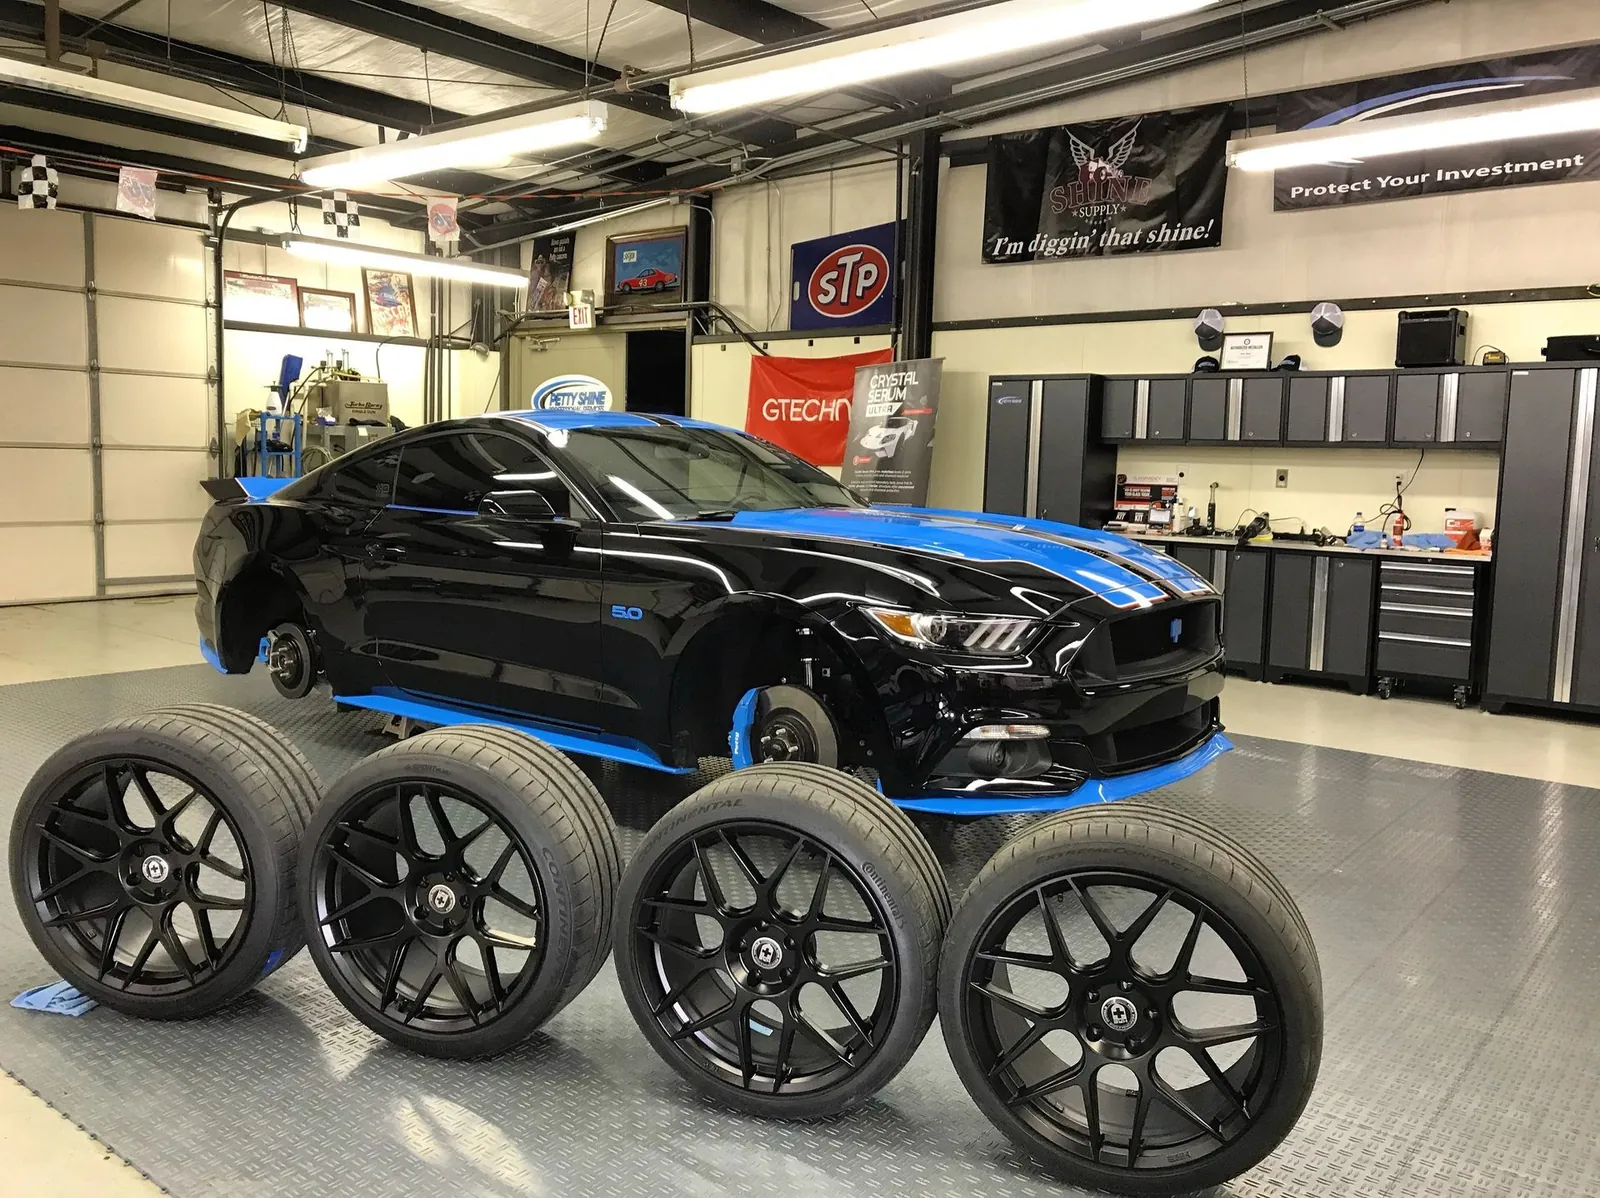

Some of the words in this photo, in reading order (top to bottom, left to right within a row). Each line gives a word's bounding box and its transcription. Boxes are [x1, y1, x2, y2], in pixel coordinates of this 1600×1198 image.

[1290, 178, 1372, 199] Protect
[1376, 171, 1430, 189] Your
[1436, 153, 1585, 182] Investment
[1049, 175, 1153, 214] SHINE
[1078, 203, 1121, 218] SUPPLY
[991, 236, 1024, 256] I'm
[1028, 229, 1097, 256] diggin'
[1099, 226, 1143, 248] that
[1146, 218, 1215, 244] shine!
[816, 250, 879, 304] STP
[573, 306, 589, 325] EXIT
[869, 371, 919, 389] CRYSTAL
[549, 392, 579, 406] PETTY
[577, 390, 607, 406] SHINE
[867, 386, 907, 404] SERUM
[868, 404, 893, 415] ULTRA
[611, 604, 643, 620] 5.0
[861, 860, 905, 921] Continental
